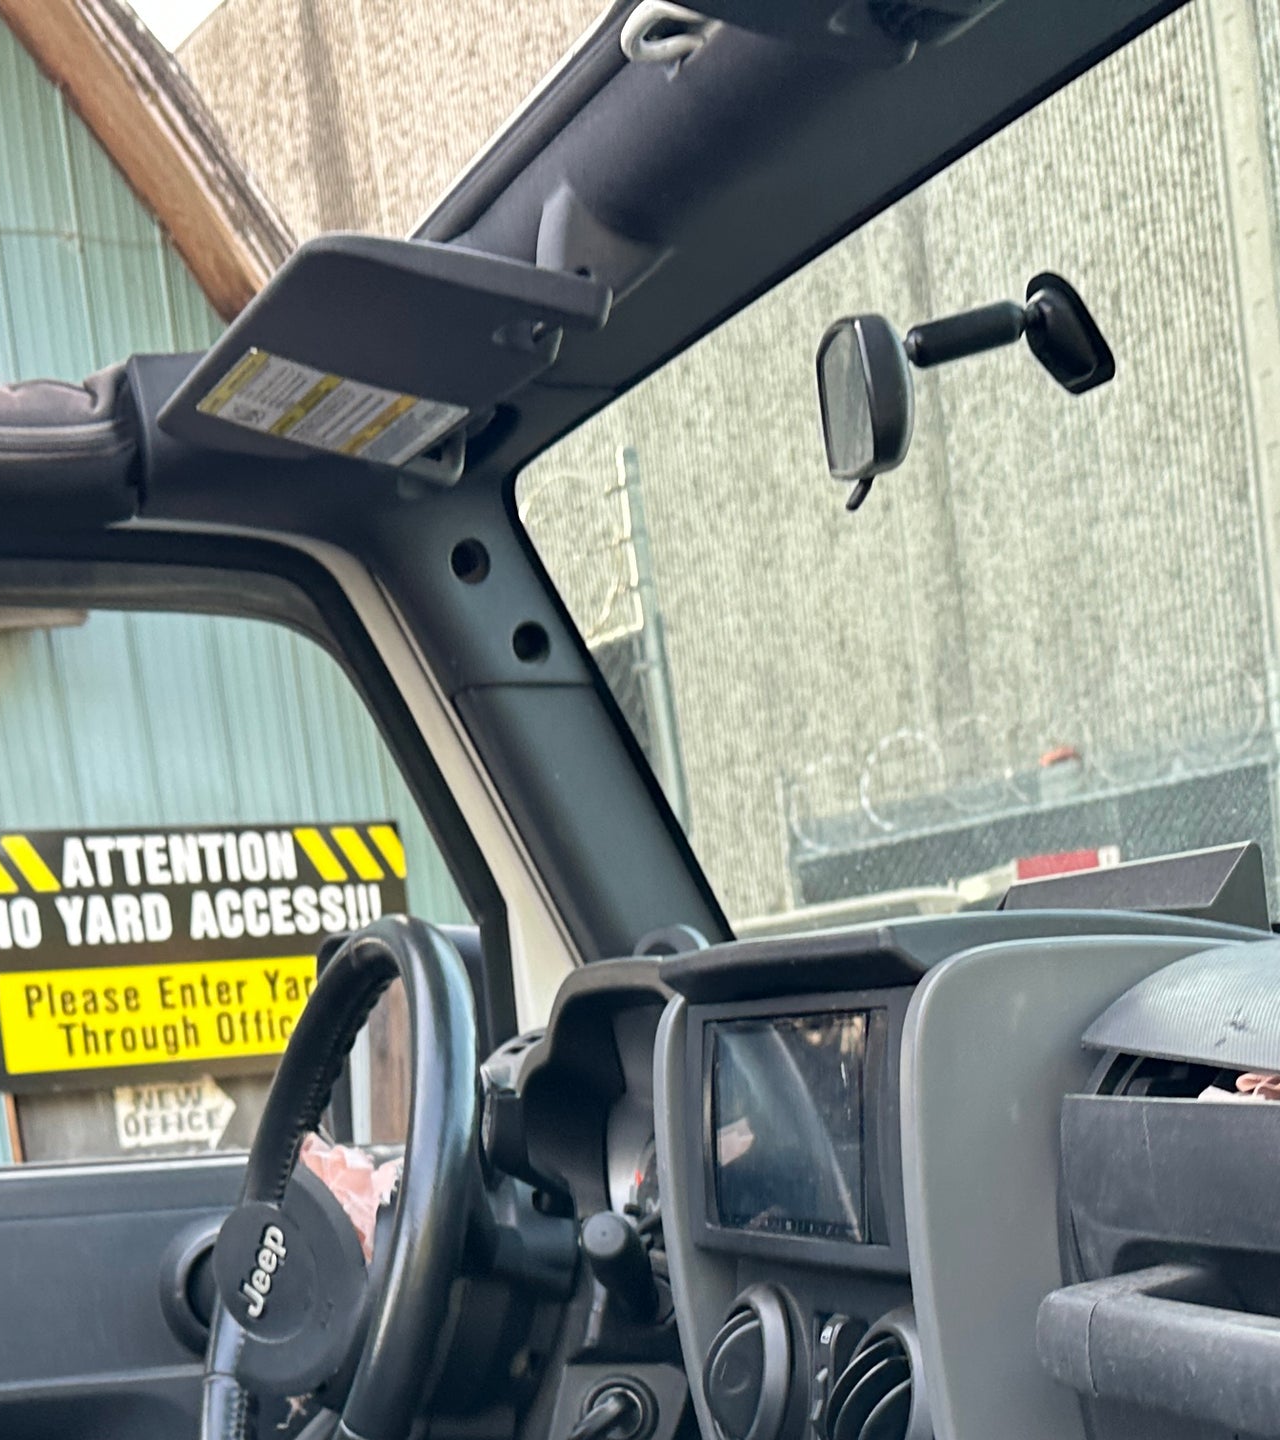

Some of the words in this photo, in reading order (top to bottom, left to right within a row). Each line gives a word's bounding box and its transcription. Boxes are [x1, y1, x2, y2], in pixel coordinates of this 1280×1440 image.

[62, 831, 298, 889] ATTENTION
[54, 891, 174, 947] YARD
[24, 982, 141, 1019] Please
[158, 973, 249, 1010] Enter
[264, 968, 318, 1003] Yar
[58, 1014, 201, 1056] Through
[216, 1008, 295, 1046] Offic
[123, 1106, 222, 1138] OFFICE
[247, 1225, 287, 1318] Jeep
